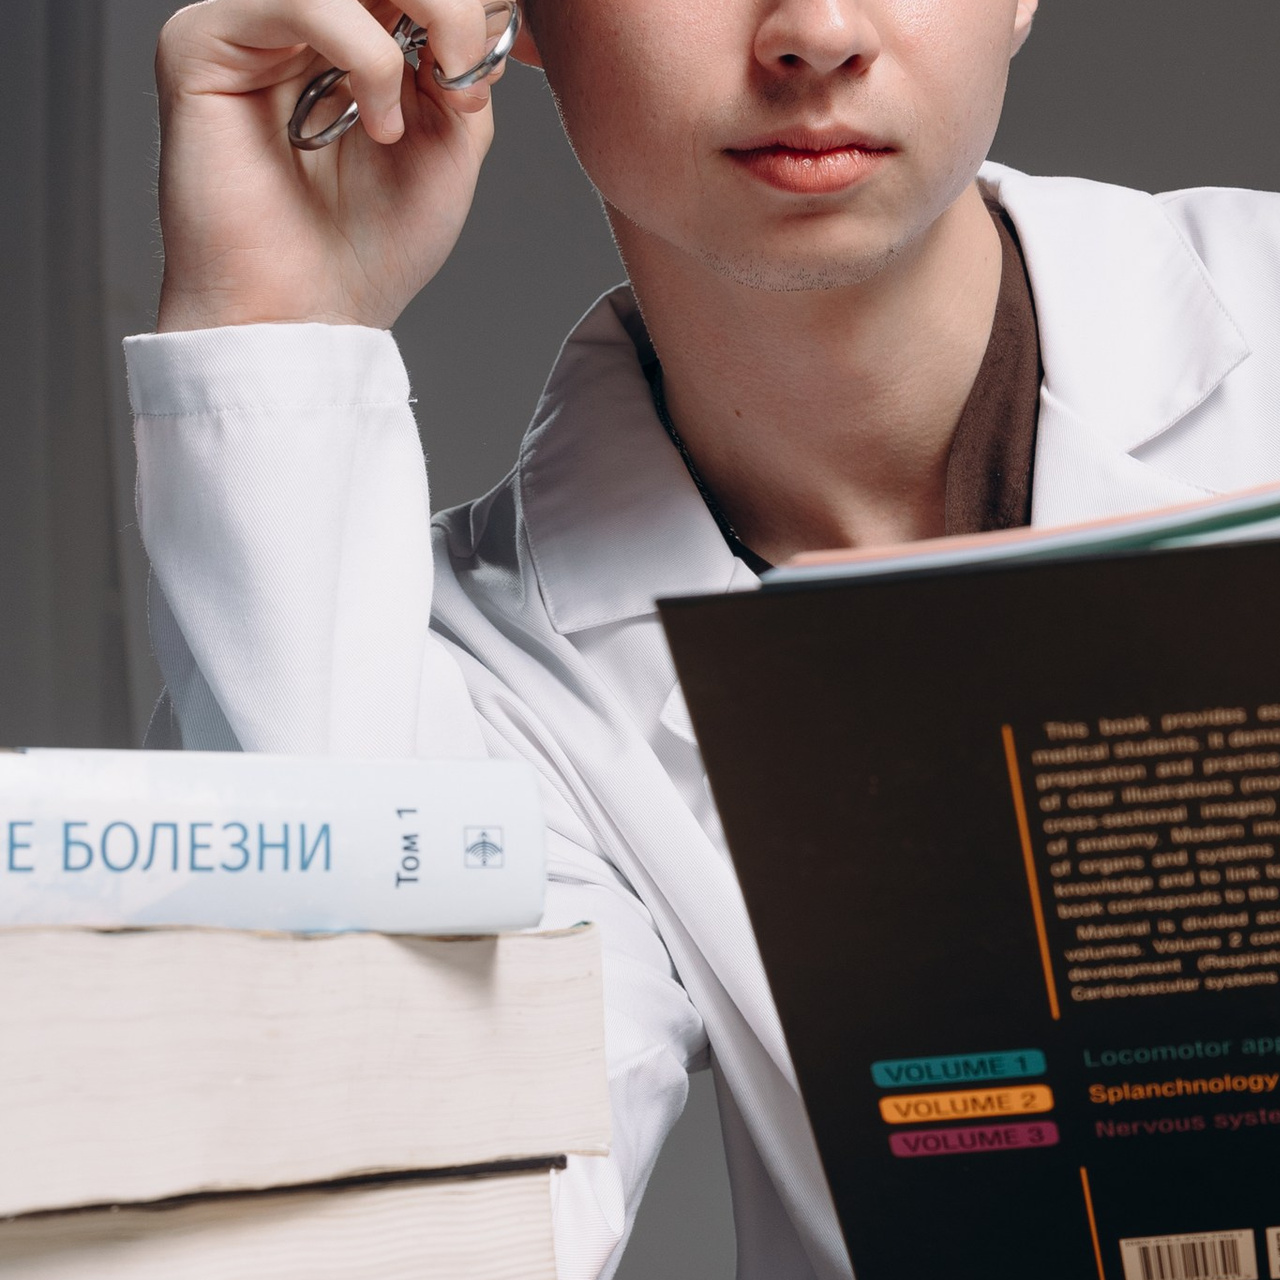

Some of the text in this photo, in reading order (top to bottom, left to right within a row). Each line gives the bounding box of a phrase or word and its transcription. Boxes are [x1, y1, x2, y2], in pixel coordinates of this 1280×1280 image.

[62, 821, 333, 873] БОЛЕЗНИ
[395, 807, 420, 888] Том 1
[1083, 1038, 1232, 1068] Locomotor
[884, 1055, 1028, 1083] VOLUME 1
[1088, 1073, 1279, 1105] Splanchnology
[892, 1091, 1038, 1118] VOLUME 2
[902, 1125, 1046, 1153] VOLUME 3
[1094, 1115, 1206, 1139] Nervous
